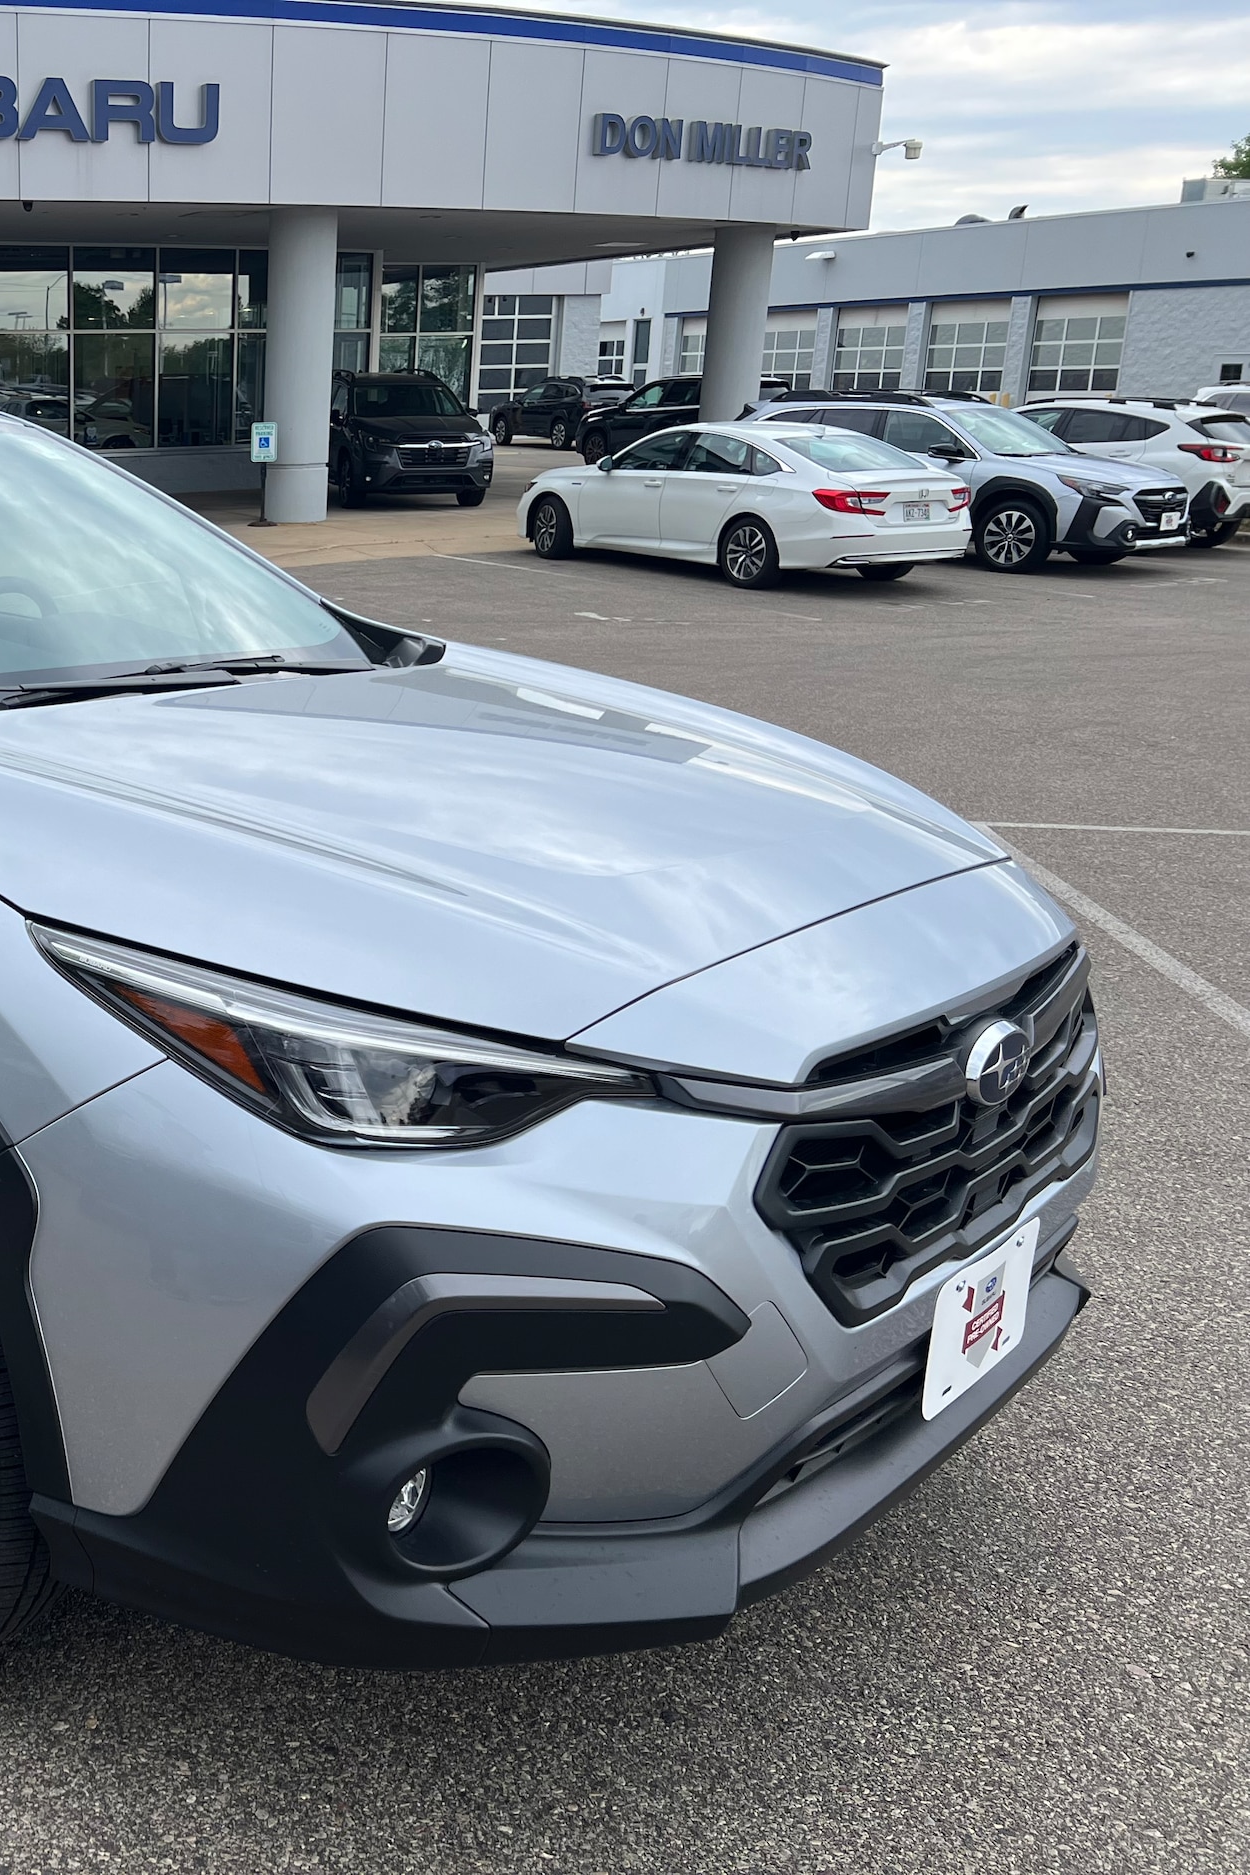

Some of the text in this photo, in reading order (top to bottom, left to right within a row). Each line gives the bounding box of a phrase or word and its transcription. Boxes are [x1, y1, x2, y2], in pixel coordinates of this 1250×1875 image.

[592, 113, 812, 170] DON MILLER
[966, 1311, 1000, 1344] PRE-OWNED
[971, 1303, 999, 1330] CERTIFIED
